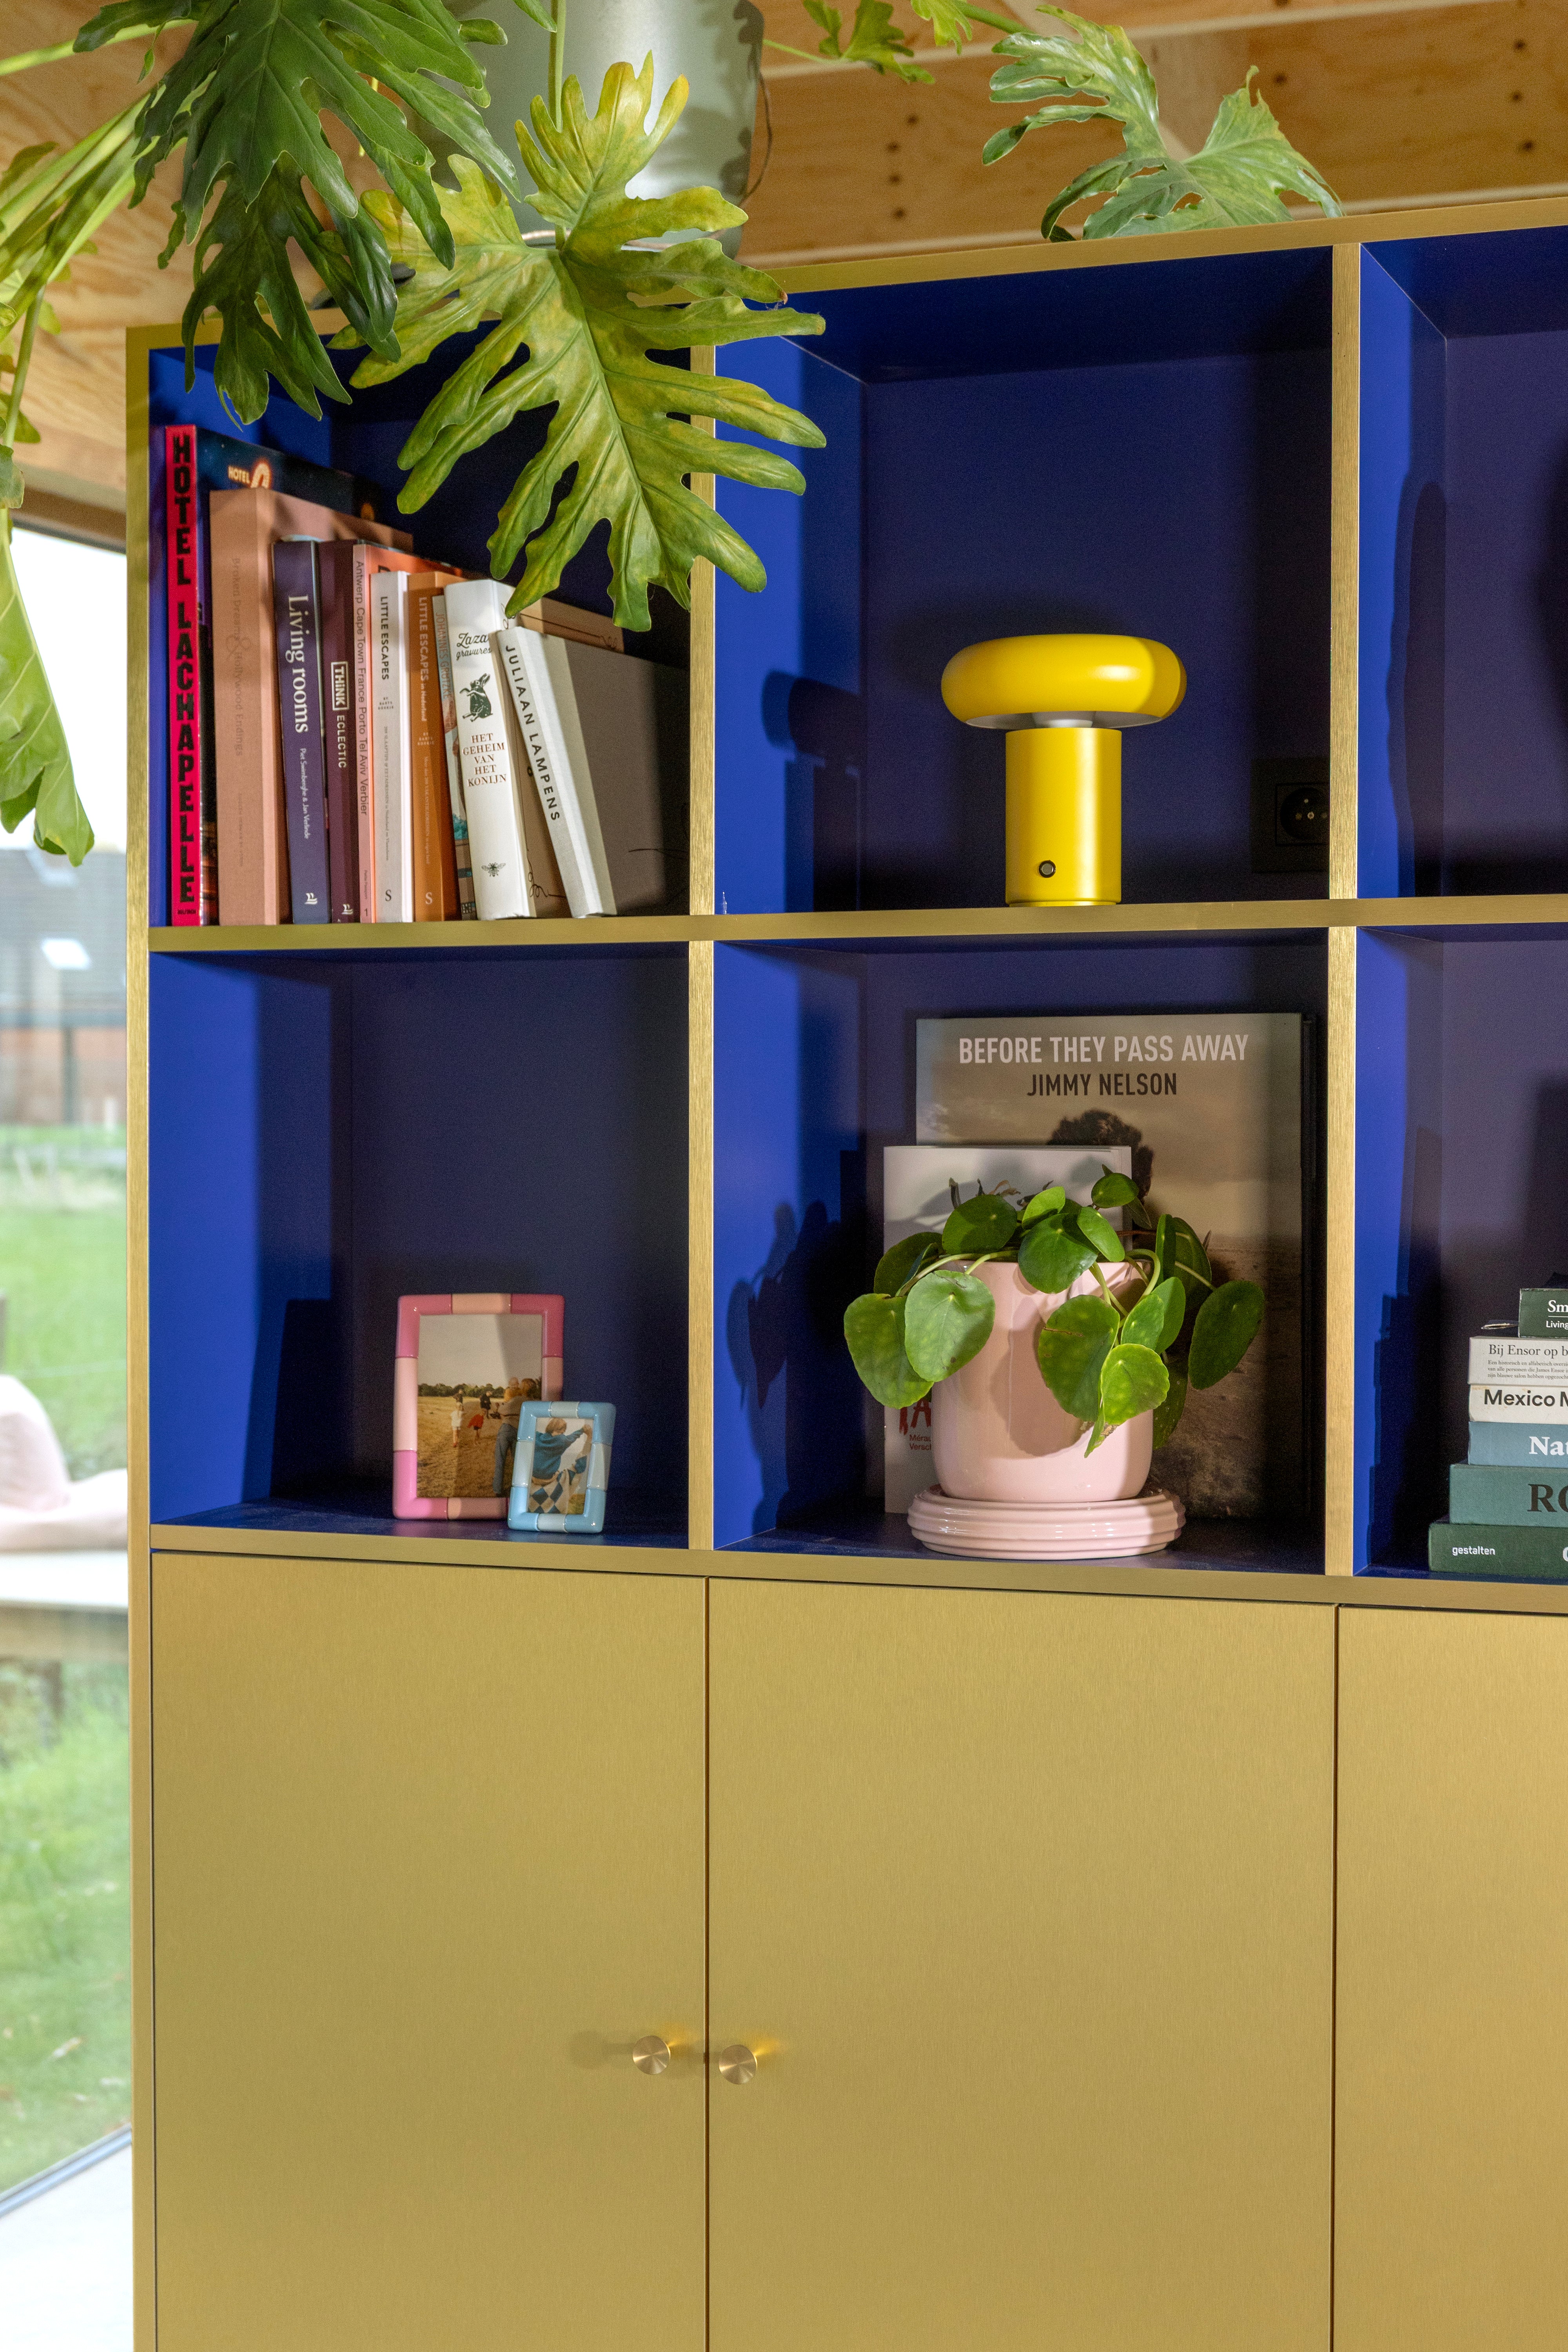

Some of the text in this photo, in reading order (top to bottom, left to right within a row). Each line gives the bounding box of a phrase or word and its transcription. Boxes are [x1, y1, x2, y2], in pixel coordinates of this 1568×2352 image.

[228, 466, 251, 485] HOTEL
[173, 435, 191, 585] HOTEL
[355, 561, 364, 603] Antwerp
[355, 608, 365, 635] Cape
[419, 597, 428, 631] LITTLE
[380, 596, 389, 680] LITTLE ESCAPES
[435, 612, 448, 659] JOHANNES
[457, 632, 489, 649] Zaza
[357, 637, 365, 663] Town
[420, 633, 429, 681] ESCAPES
[456, 648, 492, 661] gravures
[285, 595, 310, 733] Living rooms
[234, 652, 243, 710] Hollywood
[234, 714, 244, 756] Endings
[337, 715, 347, 768] ECLECTIC
[471, 733, 493, 743] HET
[506, 645, 560, 821] JULIAAN LAMPENS
[176, 602, 194, 903] LACHAPELLE
[463, 742, 505, 755] GEHEIM
[474, 754, 495, 764] VAN
[468, 774, 506, 787] KONIJN
[474, 764, 496, 775] HET
[385, 889, 392, 901] S
[425, 892, 433, 905] S
[959, 1034, 1249, 1064] BEFORE THEY PASS AWAY
[1027, 1073, 1177, 1096] JIMMY NELSON
[1546, 1320, 1568, 1330] Living
[1489, 1344, 1504, 1358] Bij
[1507, 1345, 1541, 1356] Ensor
[1544, 1348, 1558, 1359] op
[1485, 1389, 1555, 1407] Mexico
[1452, 1546, 1495, 1556] gestalten
